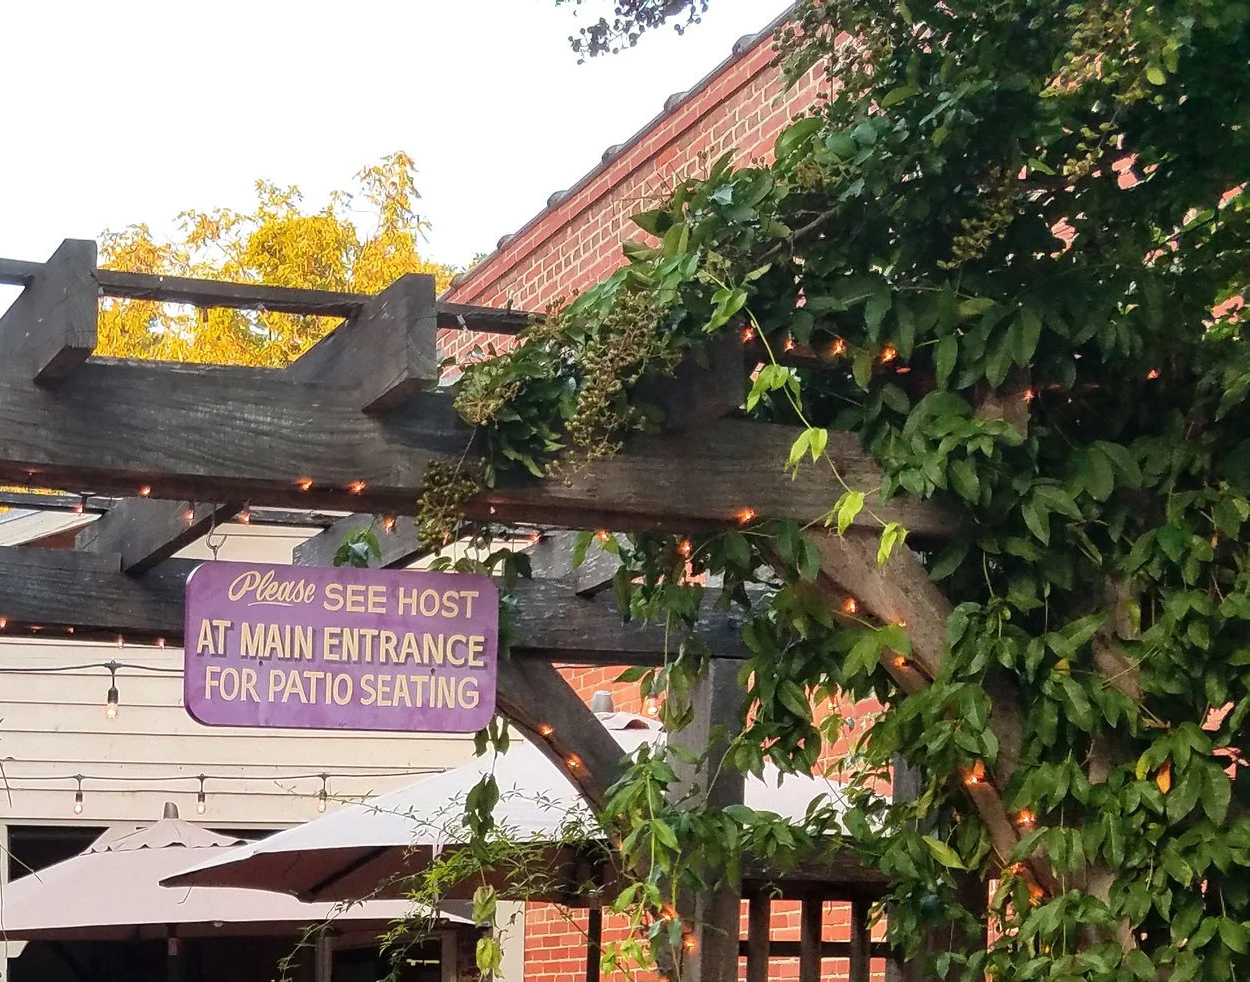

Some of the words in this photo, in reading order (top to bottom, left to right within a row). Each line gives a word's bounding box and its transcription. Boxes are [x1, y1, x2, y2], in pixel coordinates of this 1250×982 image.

[228, 569, 315, 604] Please
[323, 583, 387, 614] SEE
[398, 587, 479, 619] HOST
[197, 619, 231, 655] AT
[240, 623, 313, 661] MAIN
[323, 626, 484, 666] ENTRANCE
[205, 666, 259, 702] FOR
[269, 670, 353, 705] PATIO
[360, 674, 479, 709] SEATING
